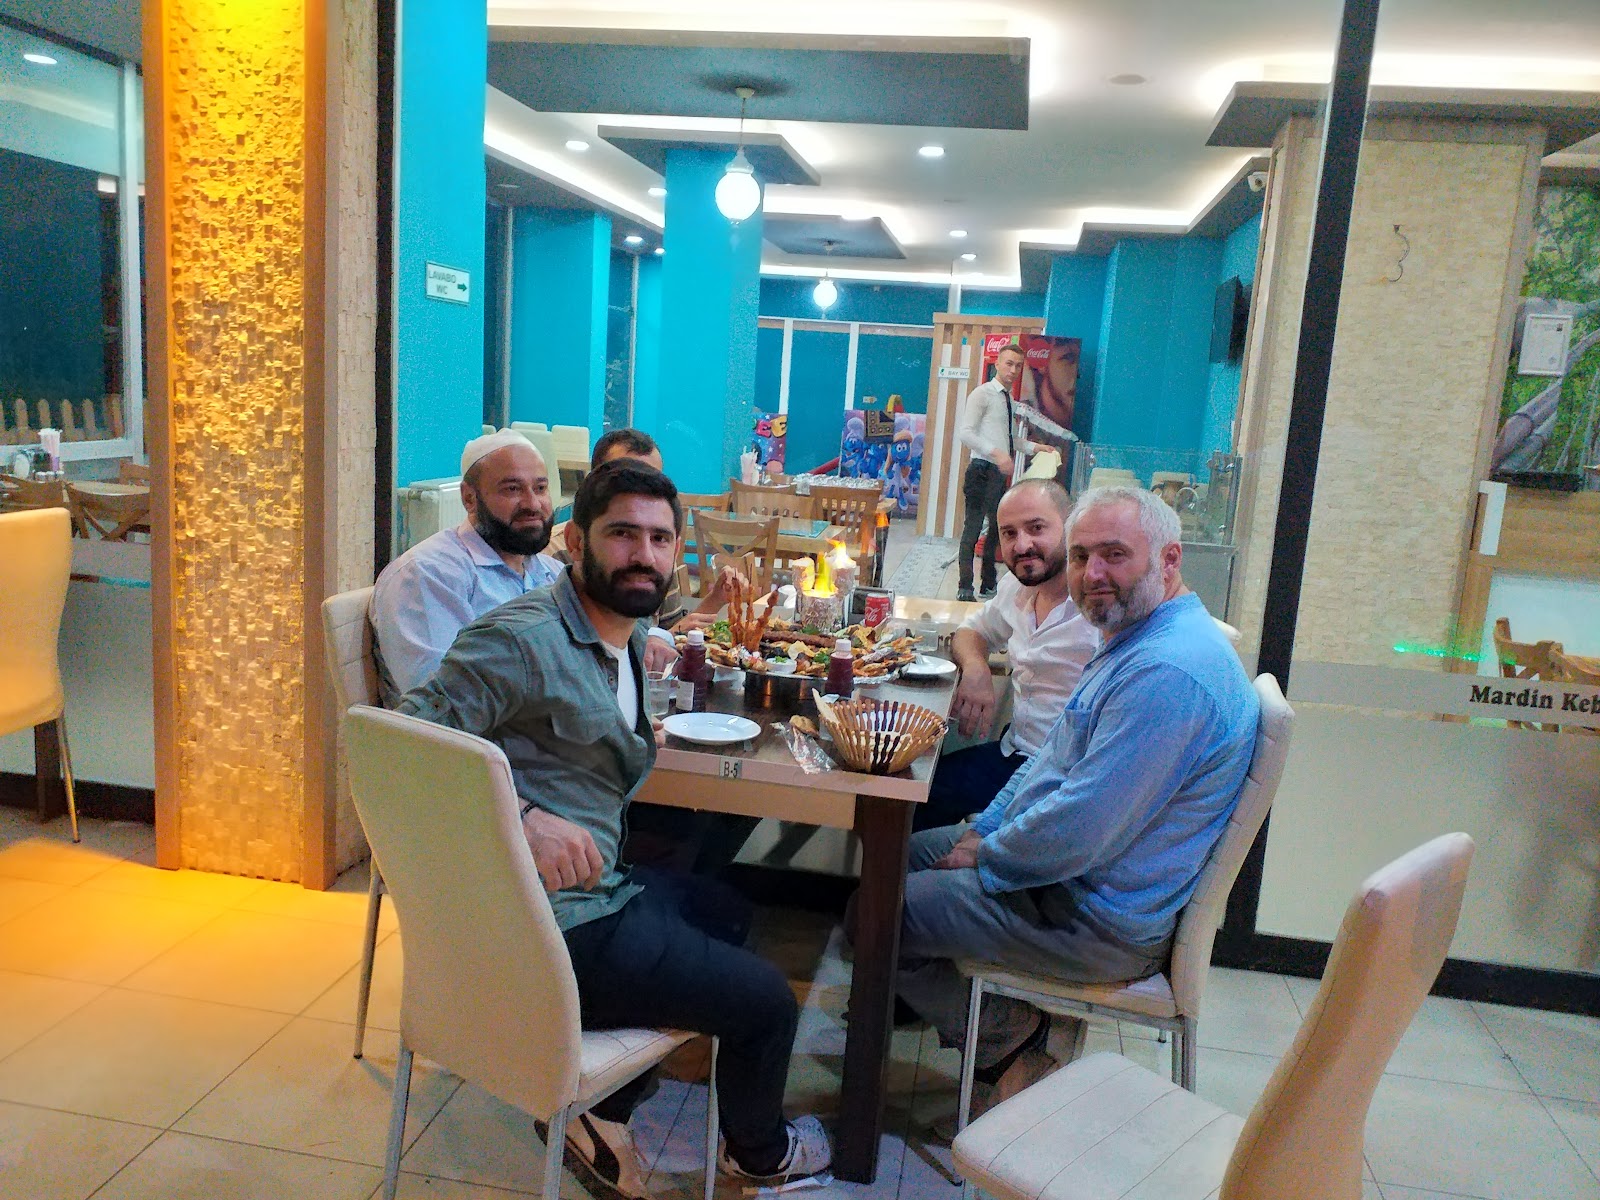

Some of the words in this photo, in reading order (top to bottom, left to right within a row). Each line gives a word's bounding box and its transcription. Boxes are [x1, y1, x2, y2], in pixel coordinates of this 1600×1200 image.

[428, 270, 457, 284] LAVABO
[436, 284, 448, 295] WC
[1469, 684, 1553, 710] Mardin
[723, 761, 739, 779] B-5
